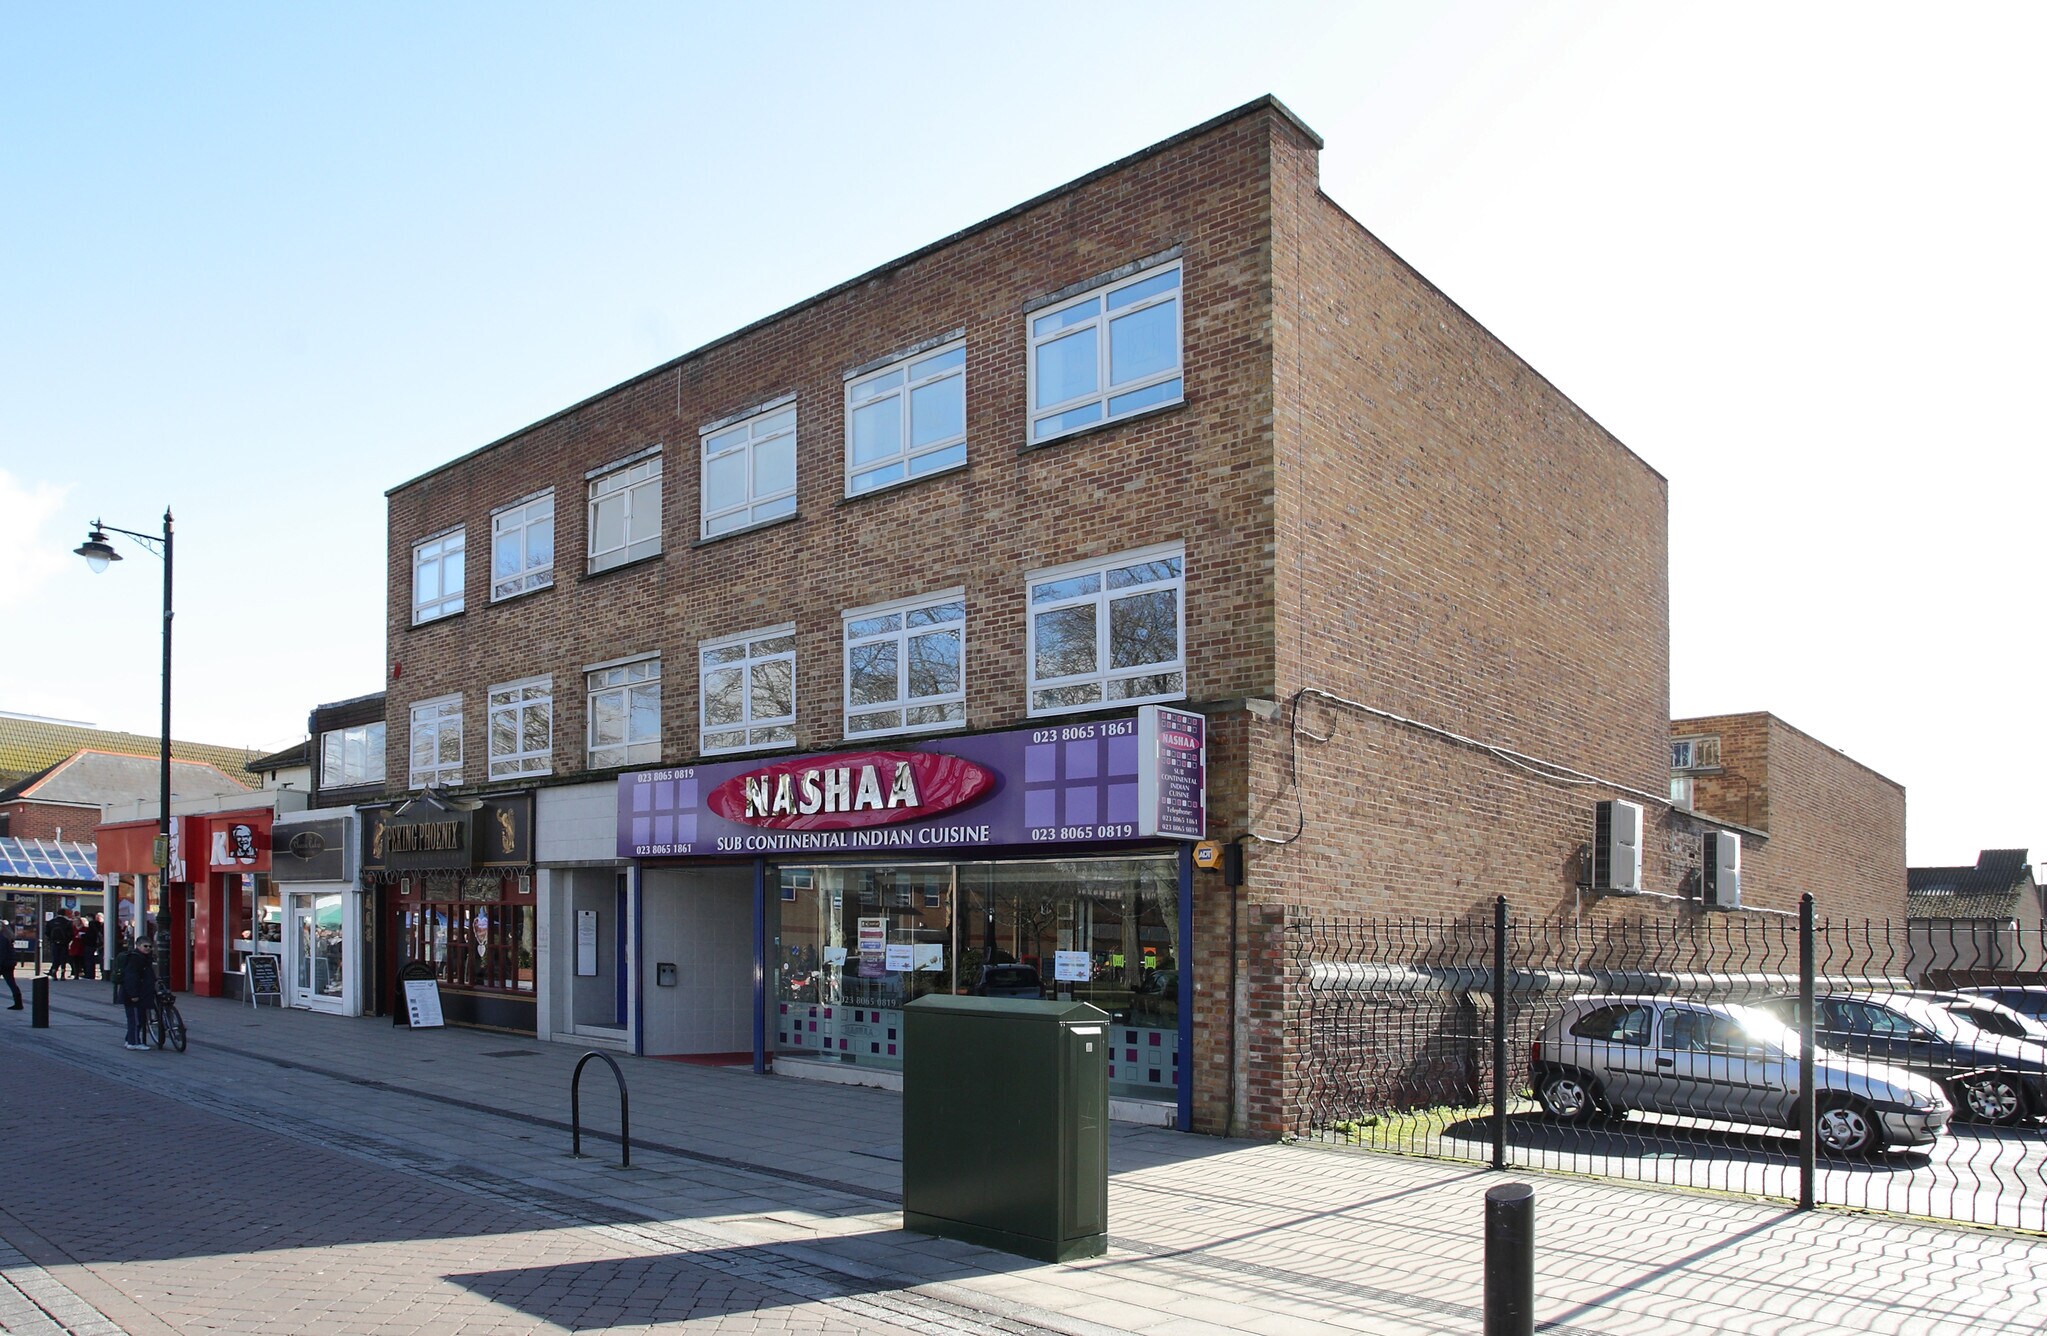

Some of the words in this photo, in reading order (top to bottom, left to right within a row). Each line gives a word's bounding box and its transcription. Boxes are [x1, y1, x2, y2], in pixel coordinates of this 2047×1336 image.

[1033, 730, 1057, 743] 023
[1062, 726, 1095, 740] 8065
[1100, 721, 1133, 736] 1861
[1162, 733, 1196, 749] NASHAA
[637, 773, 651, 783] 023
[653, 771, 672, 781] 8065
[674, 768, 694, 779] 0819
[1161, 773, 1198, 785] CONTINENTAL
[1174, 768, 1185, 776] SUB
[745, 761, 919, 818] NASHAA
[1168, 790, 1190, 799] CUISINE
[1170, 783, 1190, 792] INDIAN
[387, 823, 418, 852] PEKING
[419, 821, 458, 851] PHOENIX
[717, 836, 743, 851] SUB
[748, 832, 848, 850] CONTINENTAL
[852, 829, 914, 847] INDIAN
[918, 825, 990, 844] CUISINE
[1031, 828, 1056, 840] 023
[1060, 827, 1093, 839] 8065
[1097, 824, 1132, 838] 0819
[636, 845, 651, 855] 023
[652, 844, 671, 854] 8065
[673, 843, 692, 853] 1861
[1199, 850, 1212, 859] ADT
